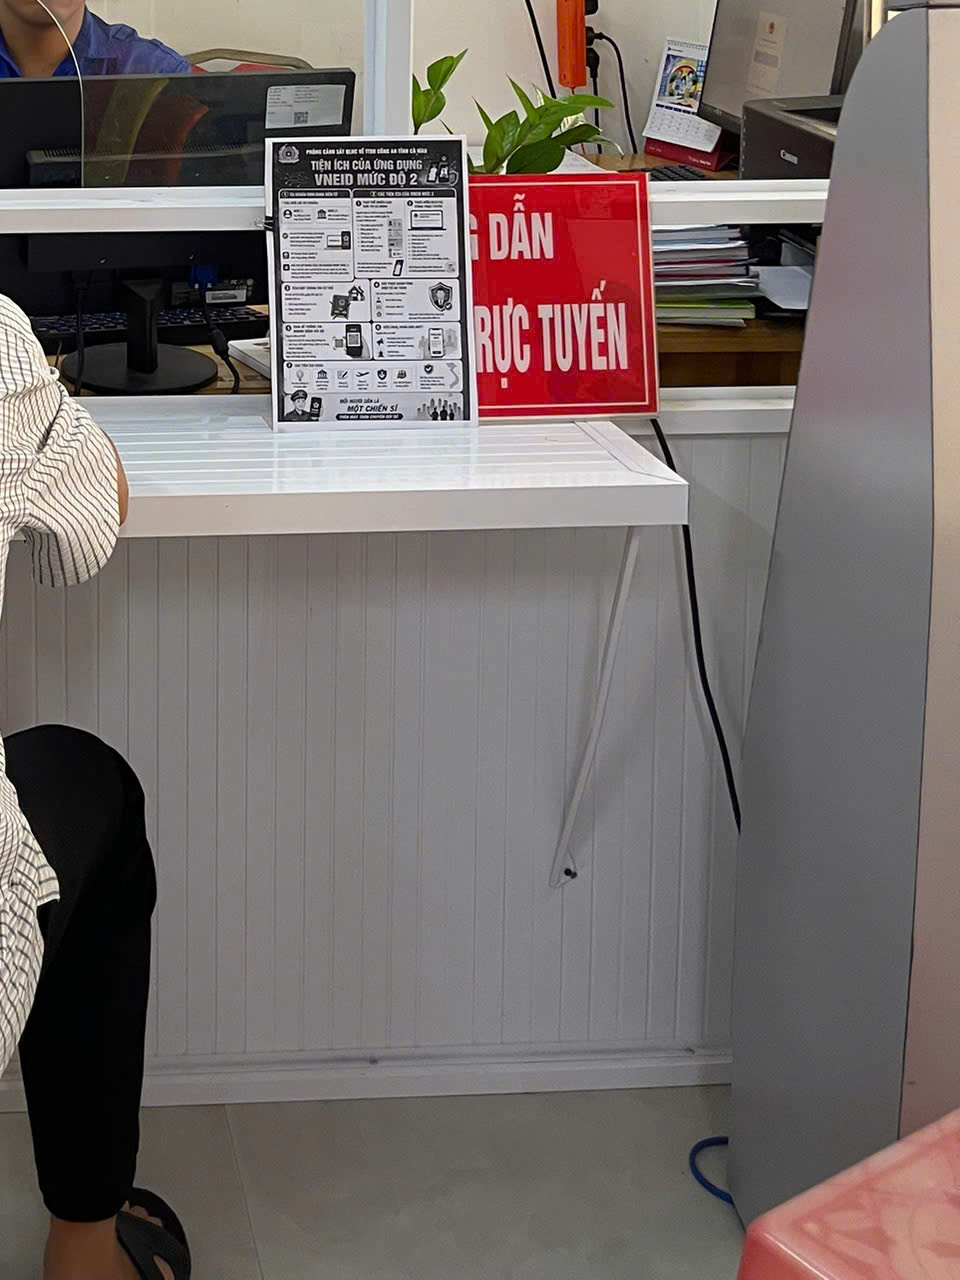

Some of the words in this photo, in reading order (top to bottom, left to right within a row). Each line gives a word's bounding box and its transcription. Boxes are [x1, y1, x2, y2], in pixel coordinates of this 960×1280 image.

[310, 159, 332, 173] TIỆN
[333, 158, 350, 171] ÍCH
[352, 157, 372, 170] CỦA
[373, 158, 394, 170] ỨNG
[396, 160, 423, 172] DỤNG
[314, 173, 354, 186] VNEID
[357, 171, 386, 186] MỨC
[389, 171, 407, 188] ĐỘ
[409, 173, 418, 186] 2
[489, 193, 555, 261] DẪN
[474, 297, 531, 389] RỰC
[537, 280, 629, 372] TUYẾN
